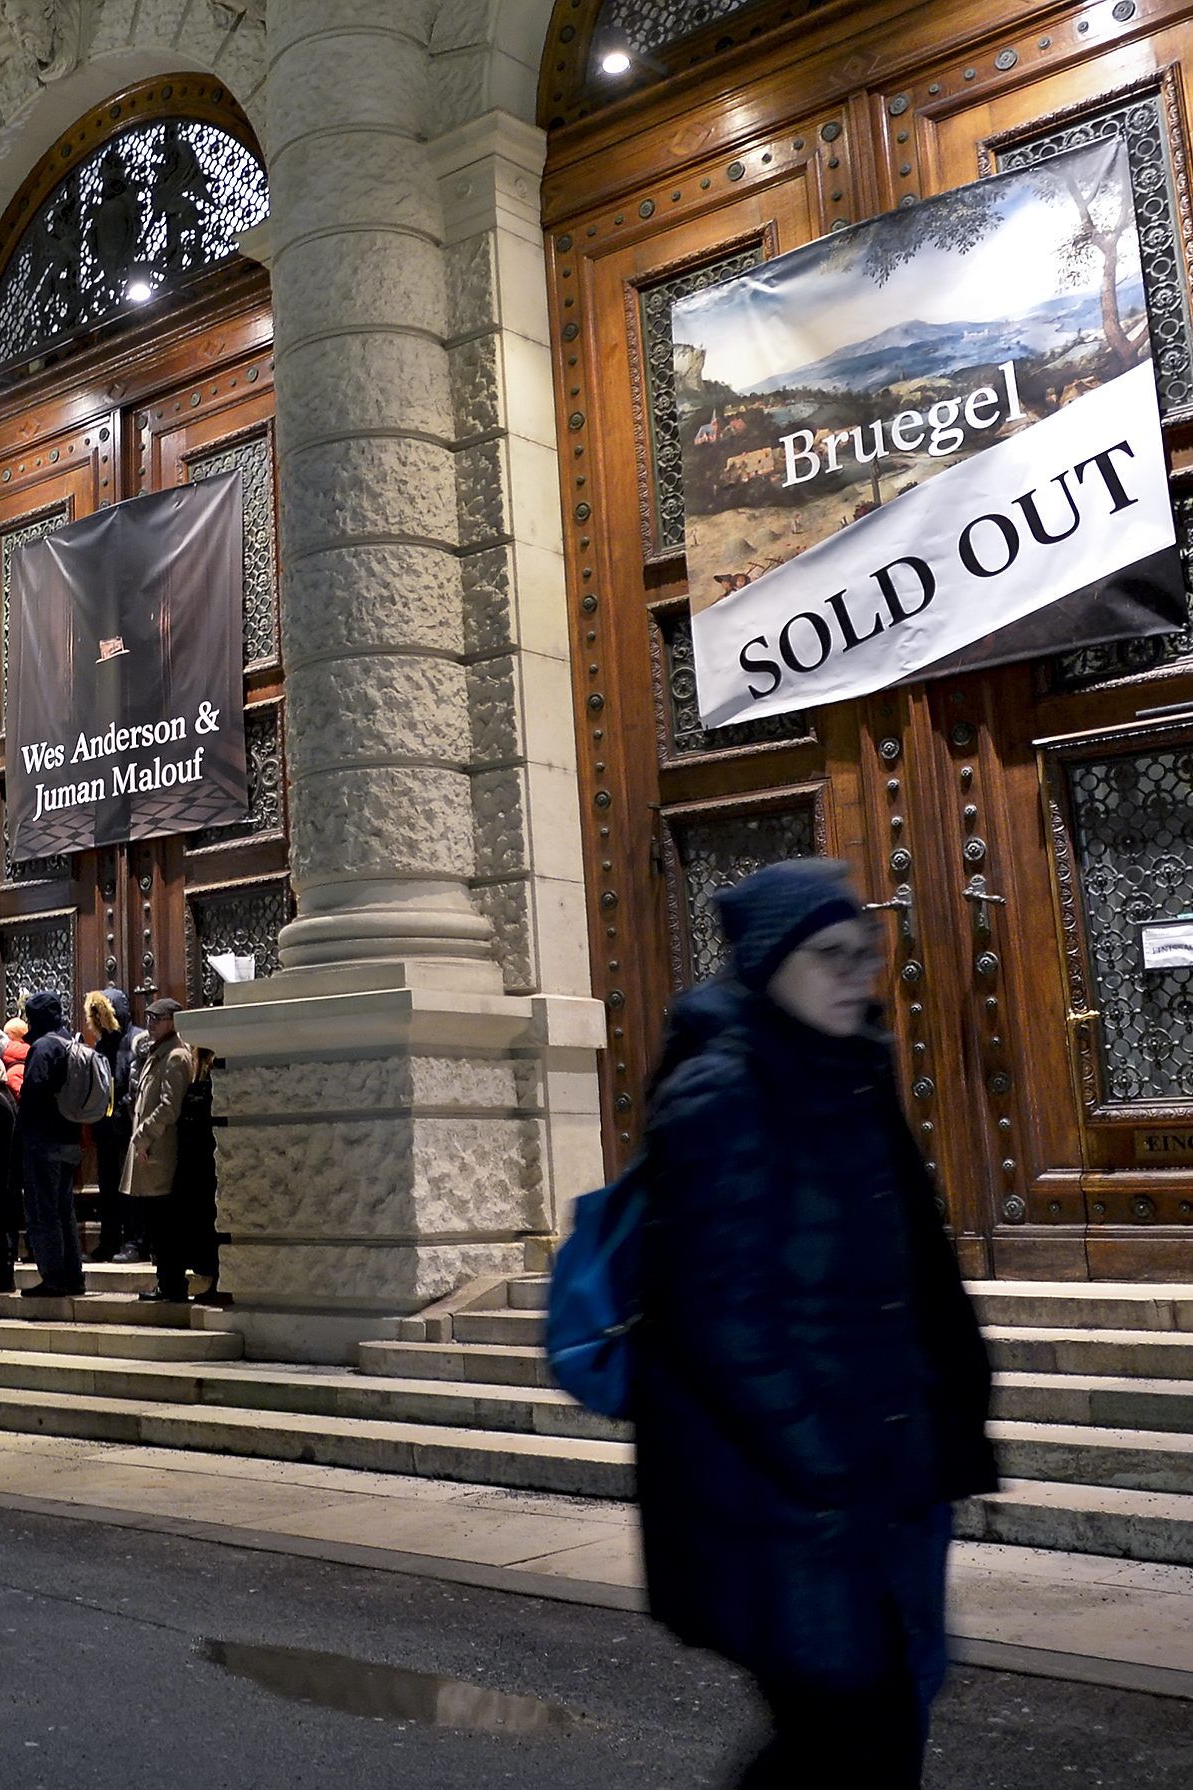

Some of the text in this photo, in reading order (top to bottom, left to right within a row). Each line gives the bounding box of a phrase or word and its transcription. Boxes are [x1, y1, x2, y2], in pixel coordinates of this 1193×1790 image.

[780, 360, 1027, 488] Bruegel
[738, 441, 1139, 700] SOLD OUT
[21, 700, 221, 775] Wes Anderson &
[32, 747, 205, 822] Juman Malouf
